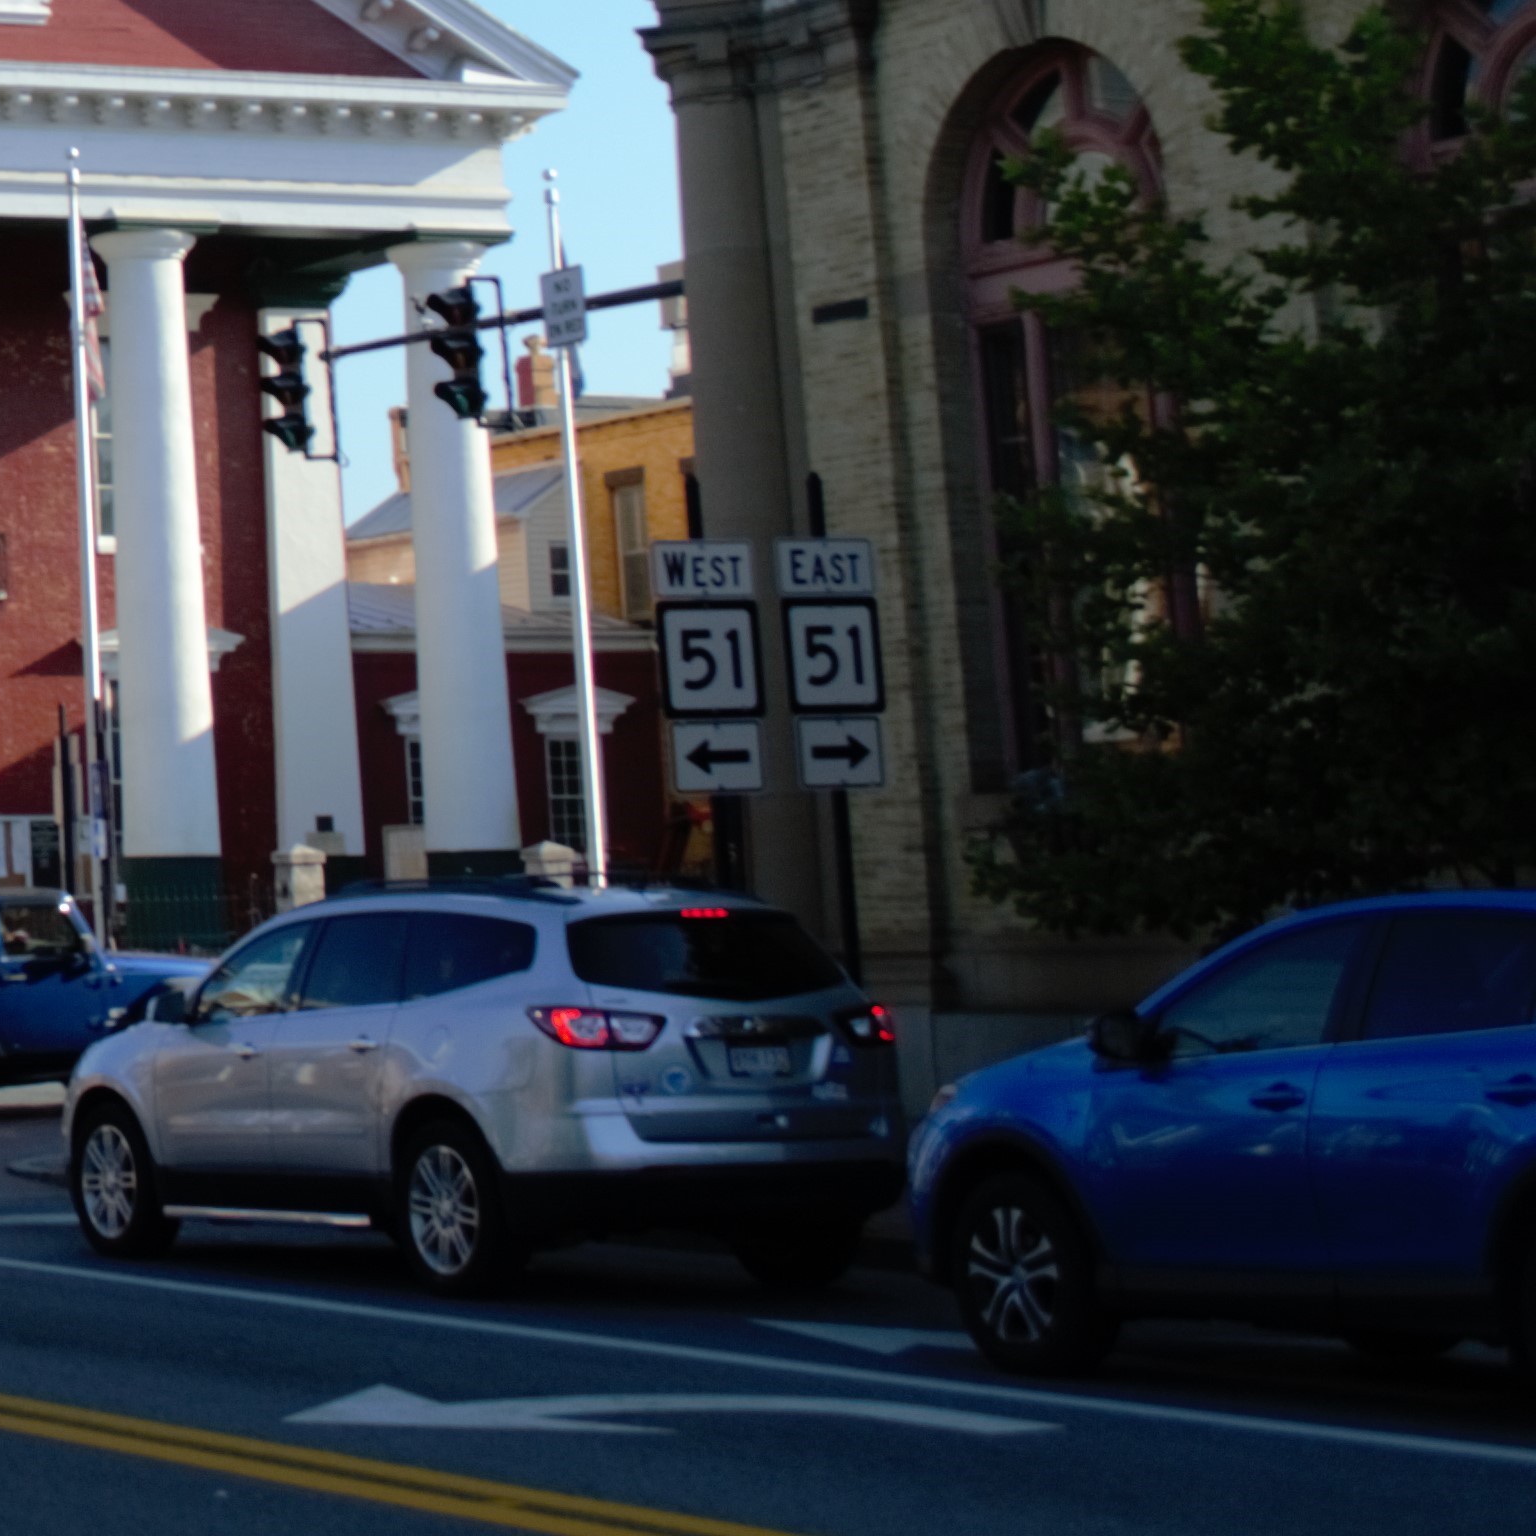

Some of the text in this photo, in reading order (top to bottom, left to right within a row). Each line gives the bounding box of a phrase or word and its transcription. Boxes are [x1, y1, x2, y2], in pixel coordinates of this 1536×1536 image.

[553, 279, 571, 293] NO
[662, 552, 743, 588] WEST
[789, 548, 862, 585] EAST
[680, 629, 744, 690] 51
[804, 625, 866, 686] 51
